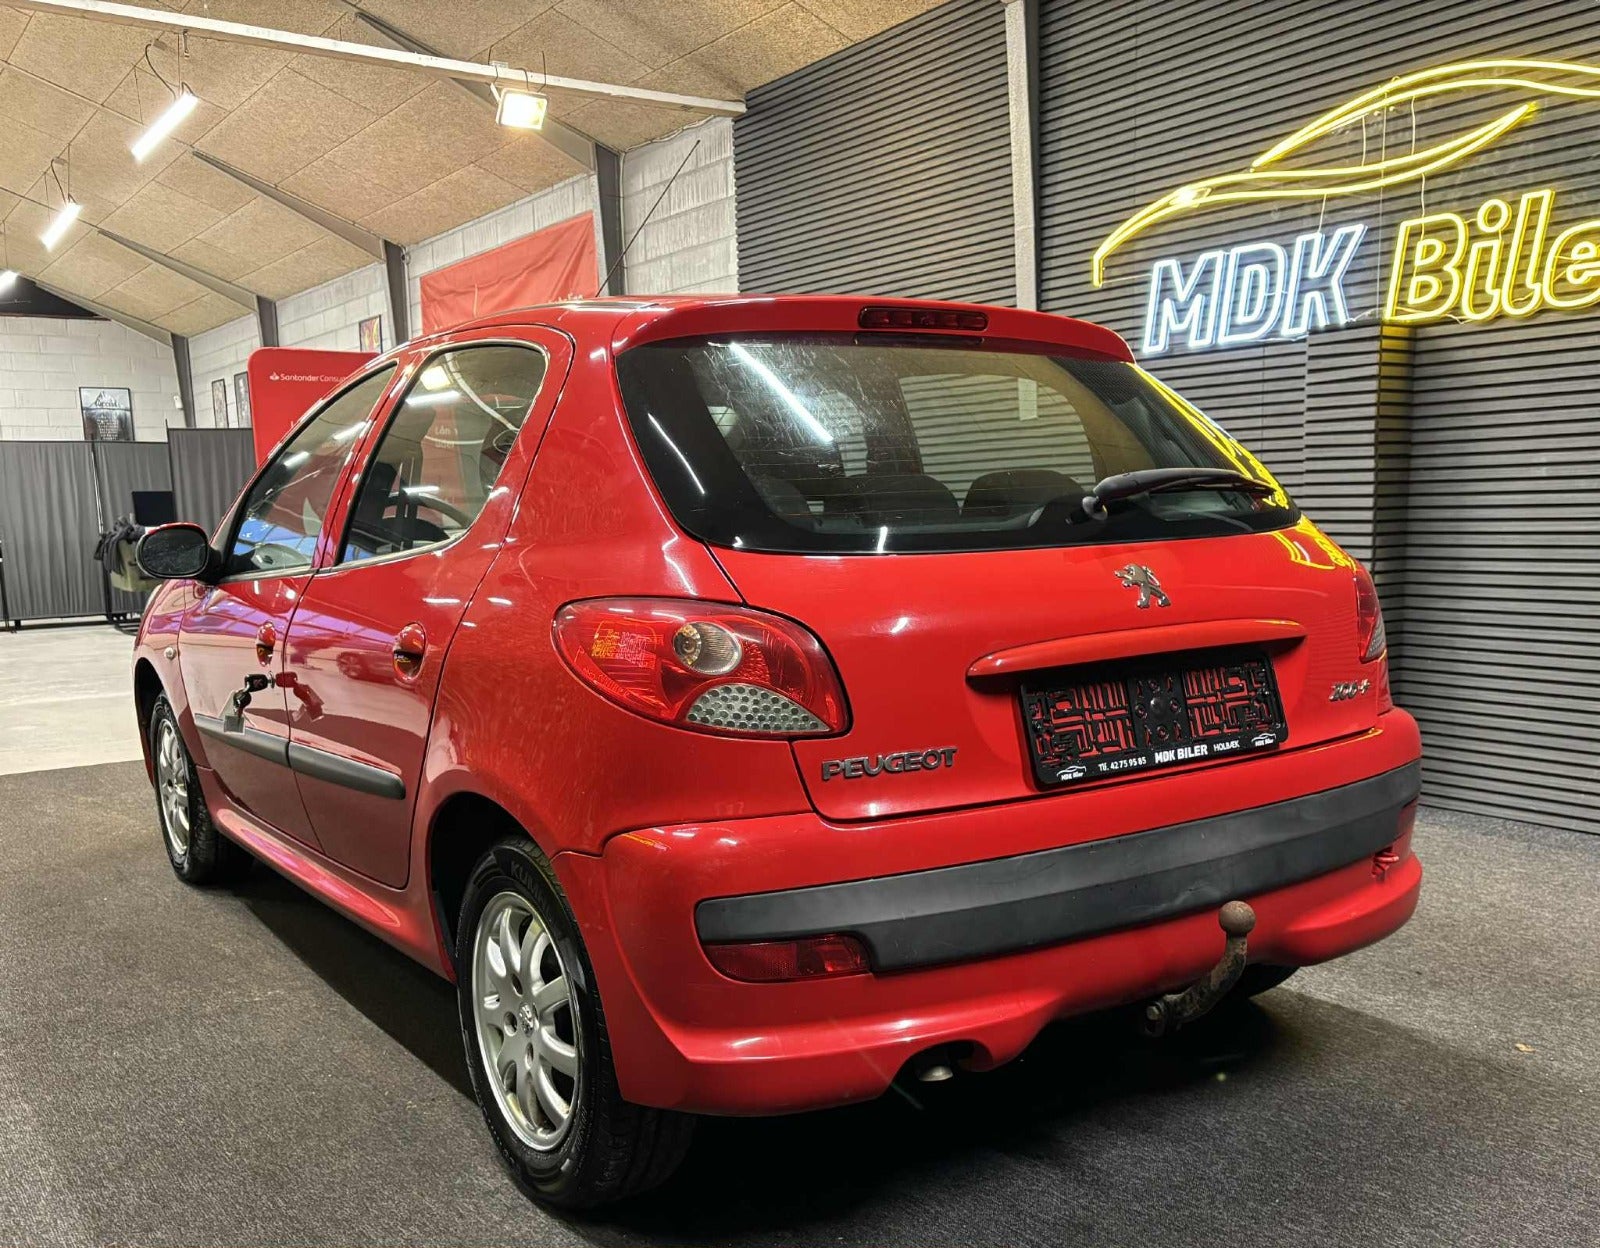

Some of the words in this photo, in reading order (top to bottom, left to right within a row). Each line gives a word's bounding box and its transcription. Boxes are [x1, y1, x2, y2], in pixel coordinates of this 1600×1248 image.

[1142, 223, 1368, 355] MDK
[280, 373, 319, 382] Santander
[822, 746, 957, 781] PEUGEOT
[1110, 761, 1119, 770] 42
[1119, 760, 1128, 768] 75
[1128, 758, 1138, 767] 95
[1138, 757, 1147, 765] 85
[1154, 750, 1175, 763] MDK
[1177, 744, 1208, 760] BILER
[1213, 740, 1240, 752] HOLBÆK
